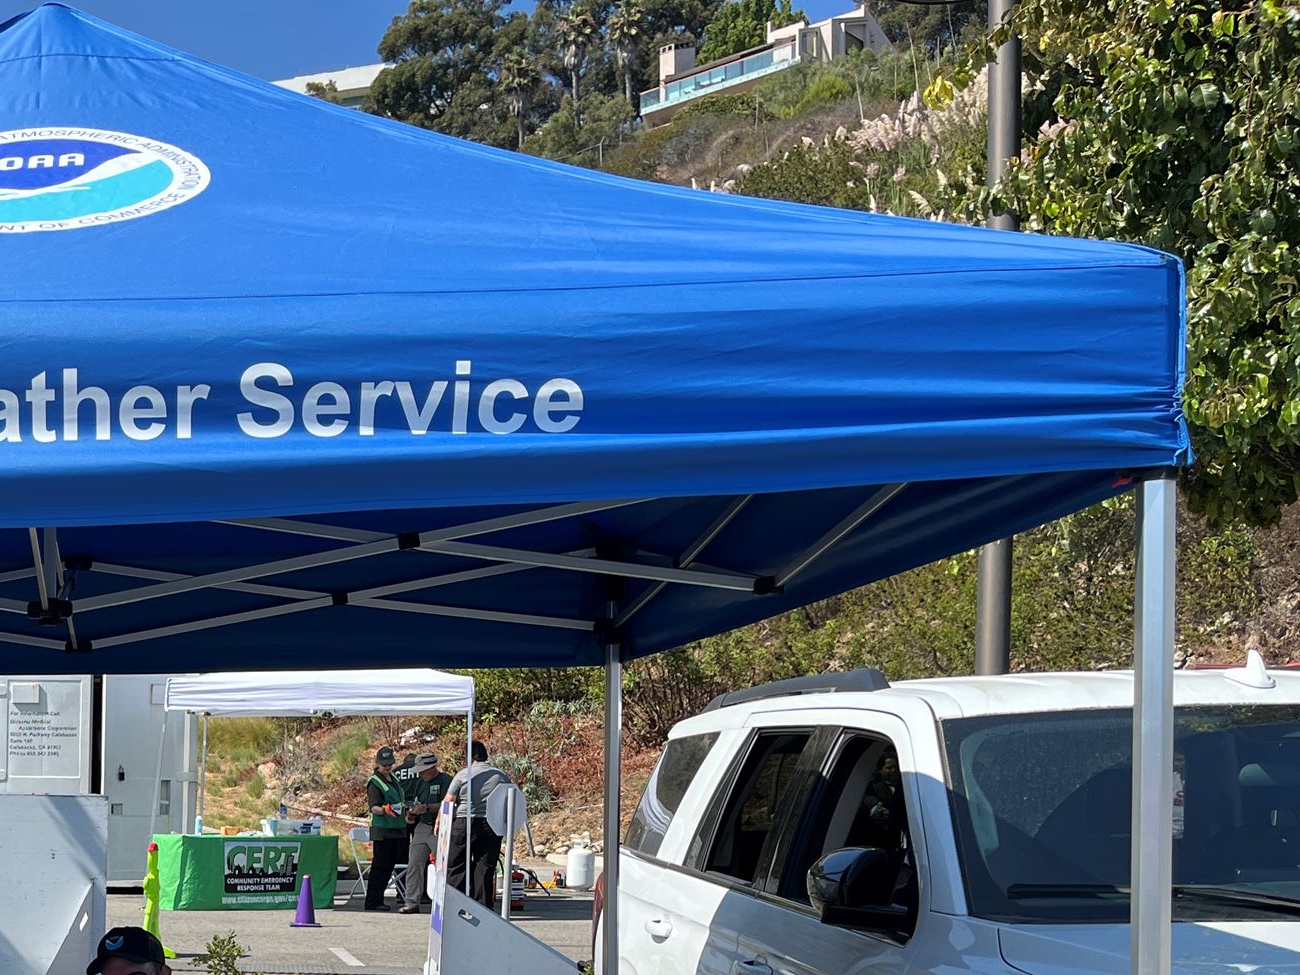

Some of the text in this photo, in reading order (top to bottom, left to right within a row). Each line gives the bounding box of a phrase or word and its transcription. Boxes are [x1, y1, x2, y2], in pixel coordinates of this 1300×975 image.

[38, 221, 71, 229] OF
[78, 191, 187, 225] COMMERCE
[237, 361, 583, 438] Service
[227, 845, 299, 876] CERT
[226, 876, 294, 885] COMMUNITY EMERGENCY
[236, 884, 265, 892] RESPONSE
